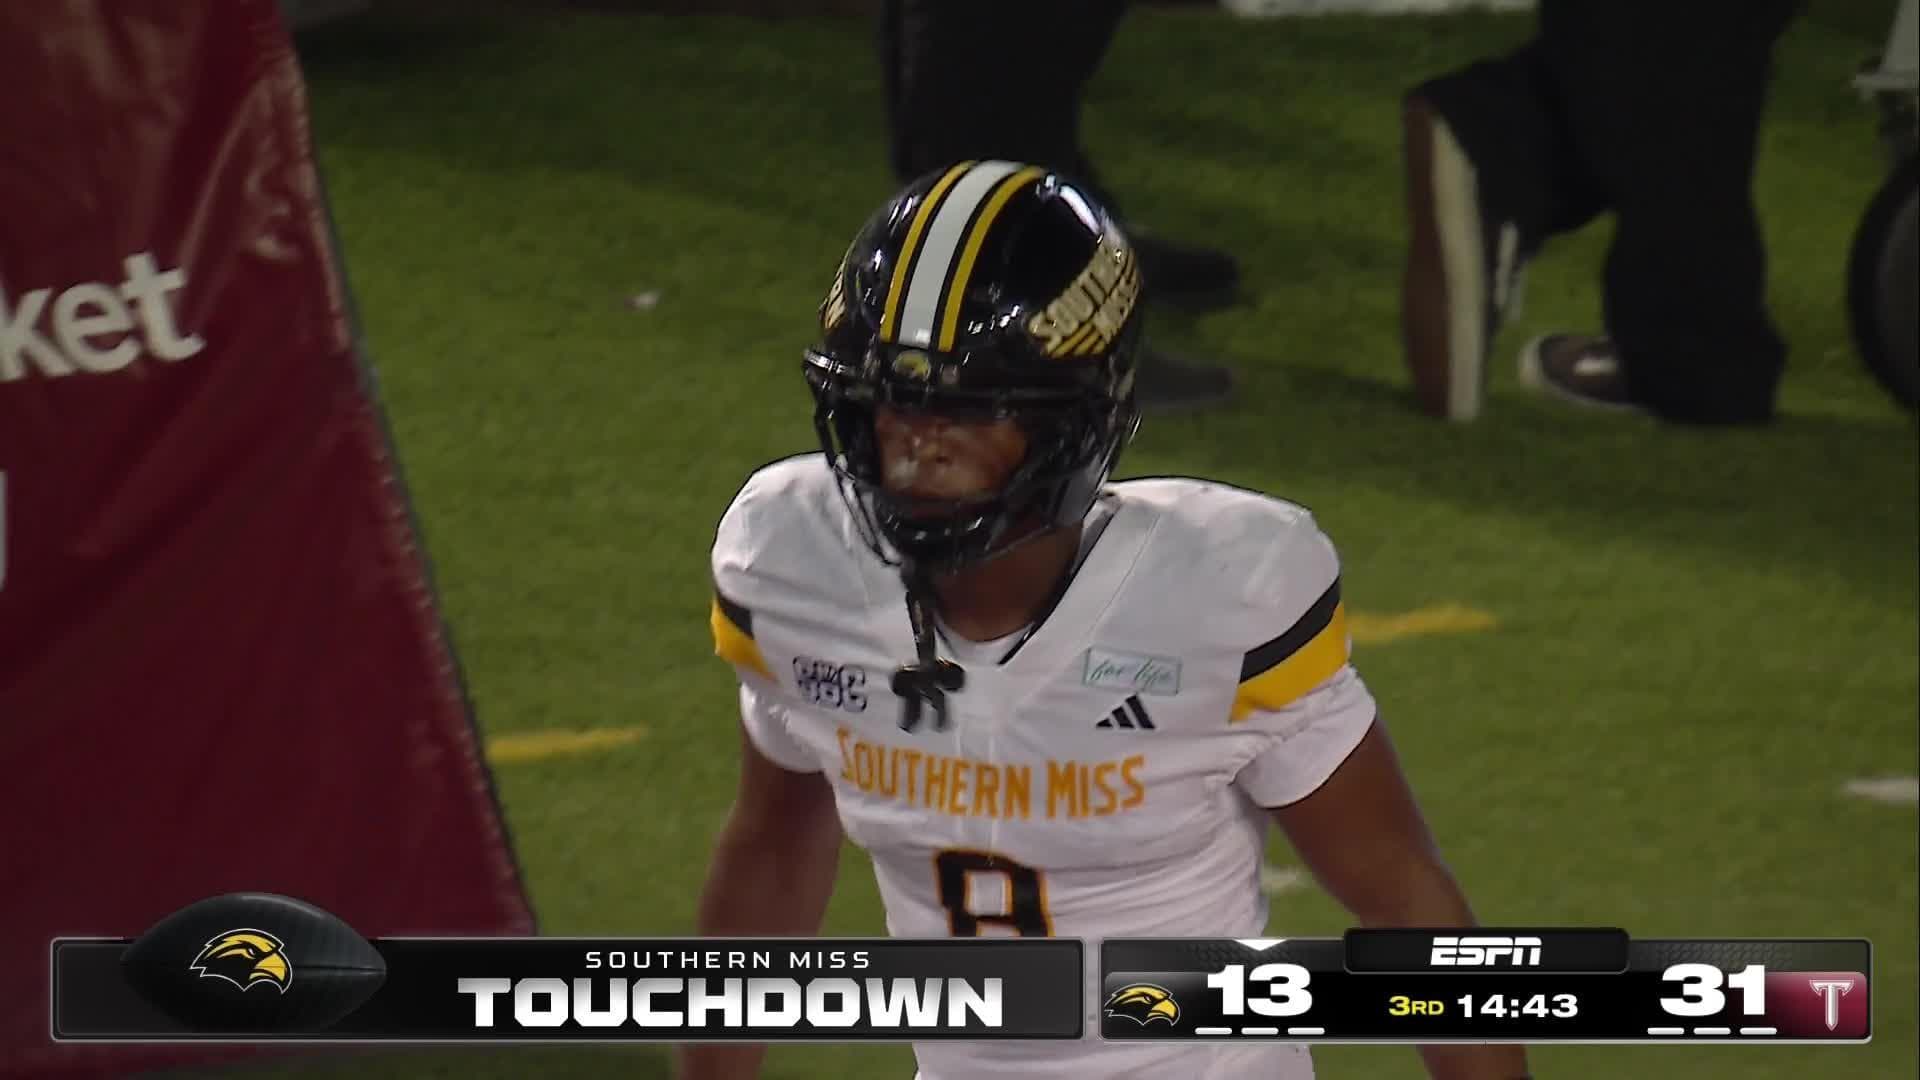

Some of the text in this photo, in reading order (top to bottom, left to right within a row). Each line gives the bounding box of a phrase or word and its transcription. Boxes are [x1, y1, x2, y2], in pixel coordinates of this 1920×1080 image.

[0, 251, 206, 380] ket
[836, 727, 1146, 819] SOUTHERN MISS
